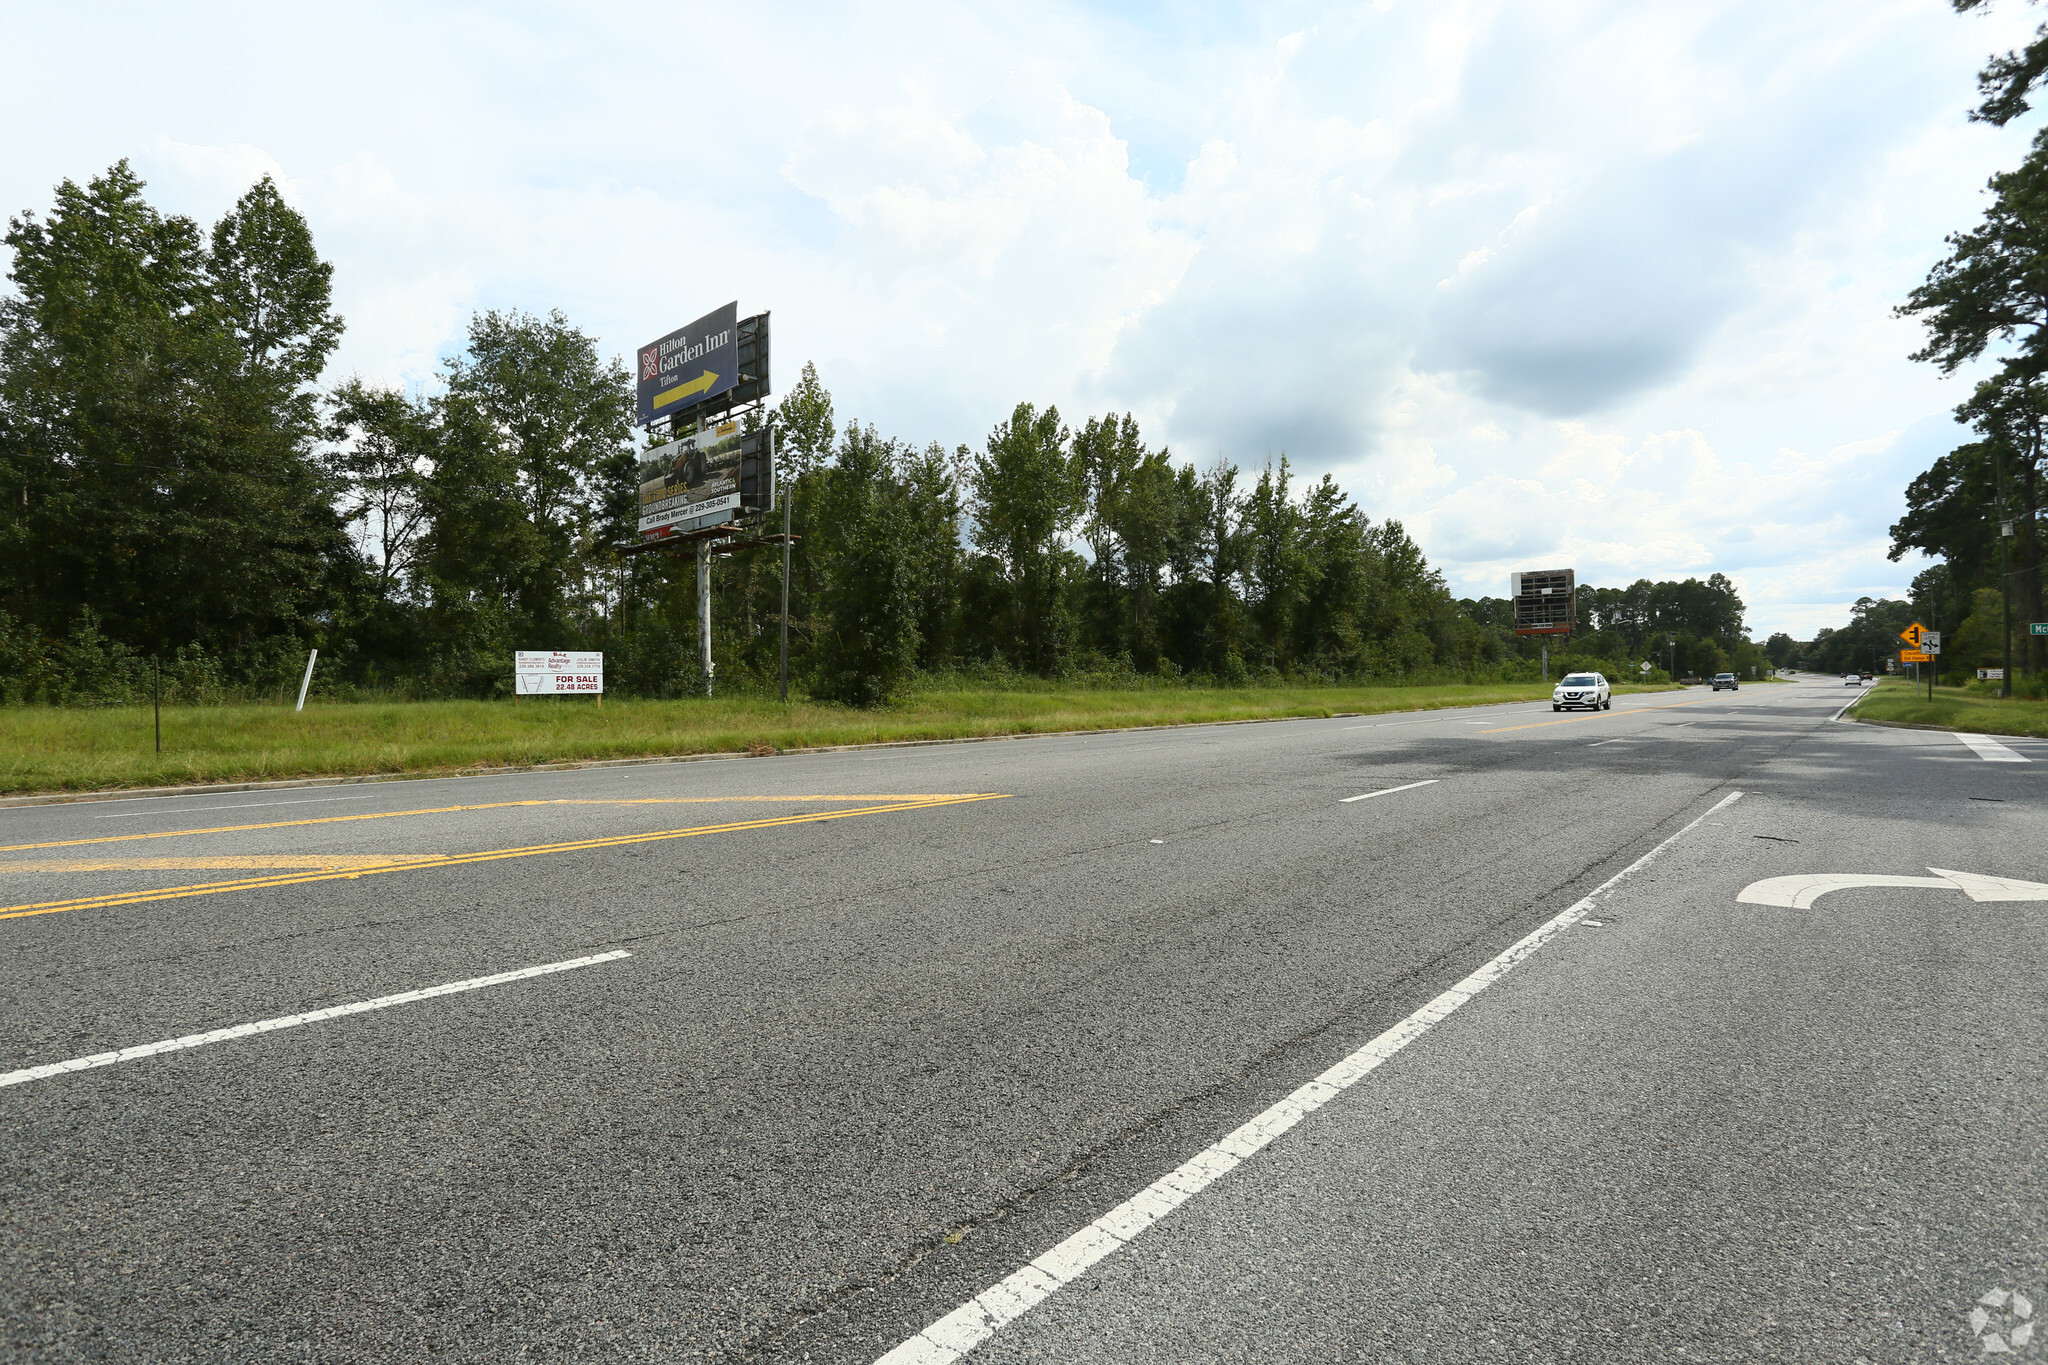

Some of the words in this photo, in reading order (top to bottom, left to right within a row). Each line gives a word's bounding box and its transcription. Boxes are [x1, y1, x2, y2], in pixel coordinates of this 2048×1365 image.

[659, 336, 686, 357] Hilton
[659, 343, 703, 374] Garden
[660, 375, 678, 388] Tifton
[667, 481, 688, 496] SERIES
[711, 478, 733, 488] ATLANTIC
[711, 483, 736, 494] SOUTHERN
[646, 515, 656, 525] Call
[656, 513, 670, 522] Brady
[670, 508, 688, 519] Mercer
[688, 505, 695, 515] @
[695, 496, 729, 511] 229-305-0541
[2035, 625, 2048, 633] Mc
[548, 657, 571, 665] Advantage
